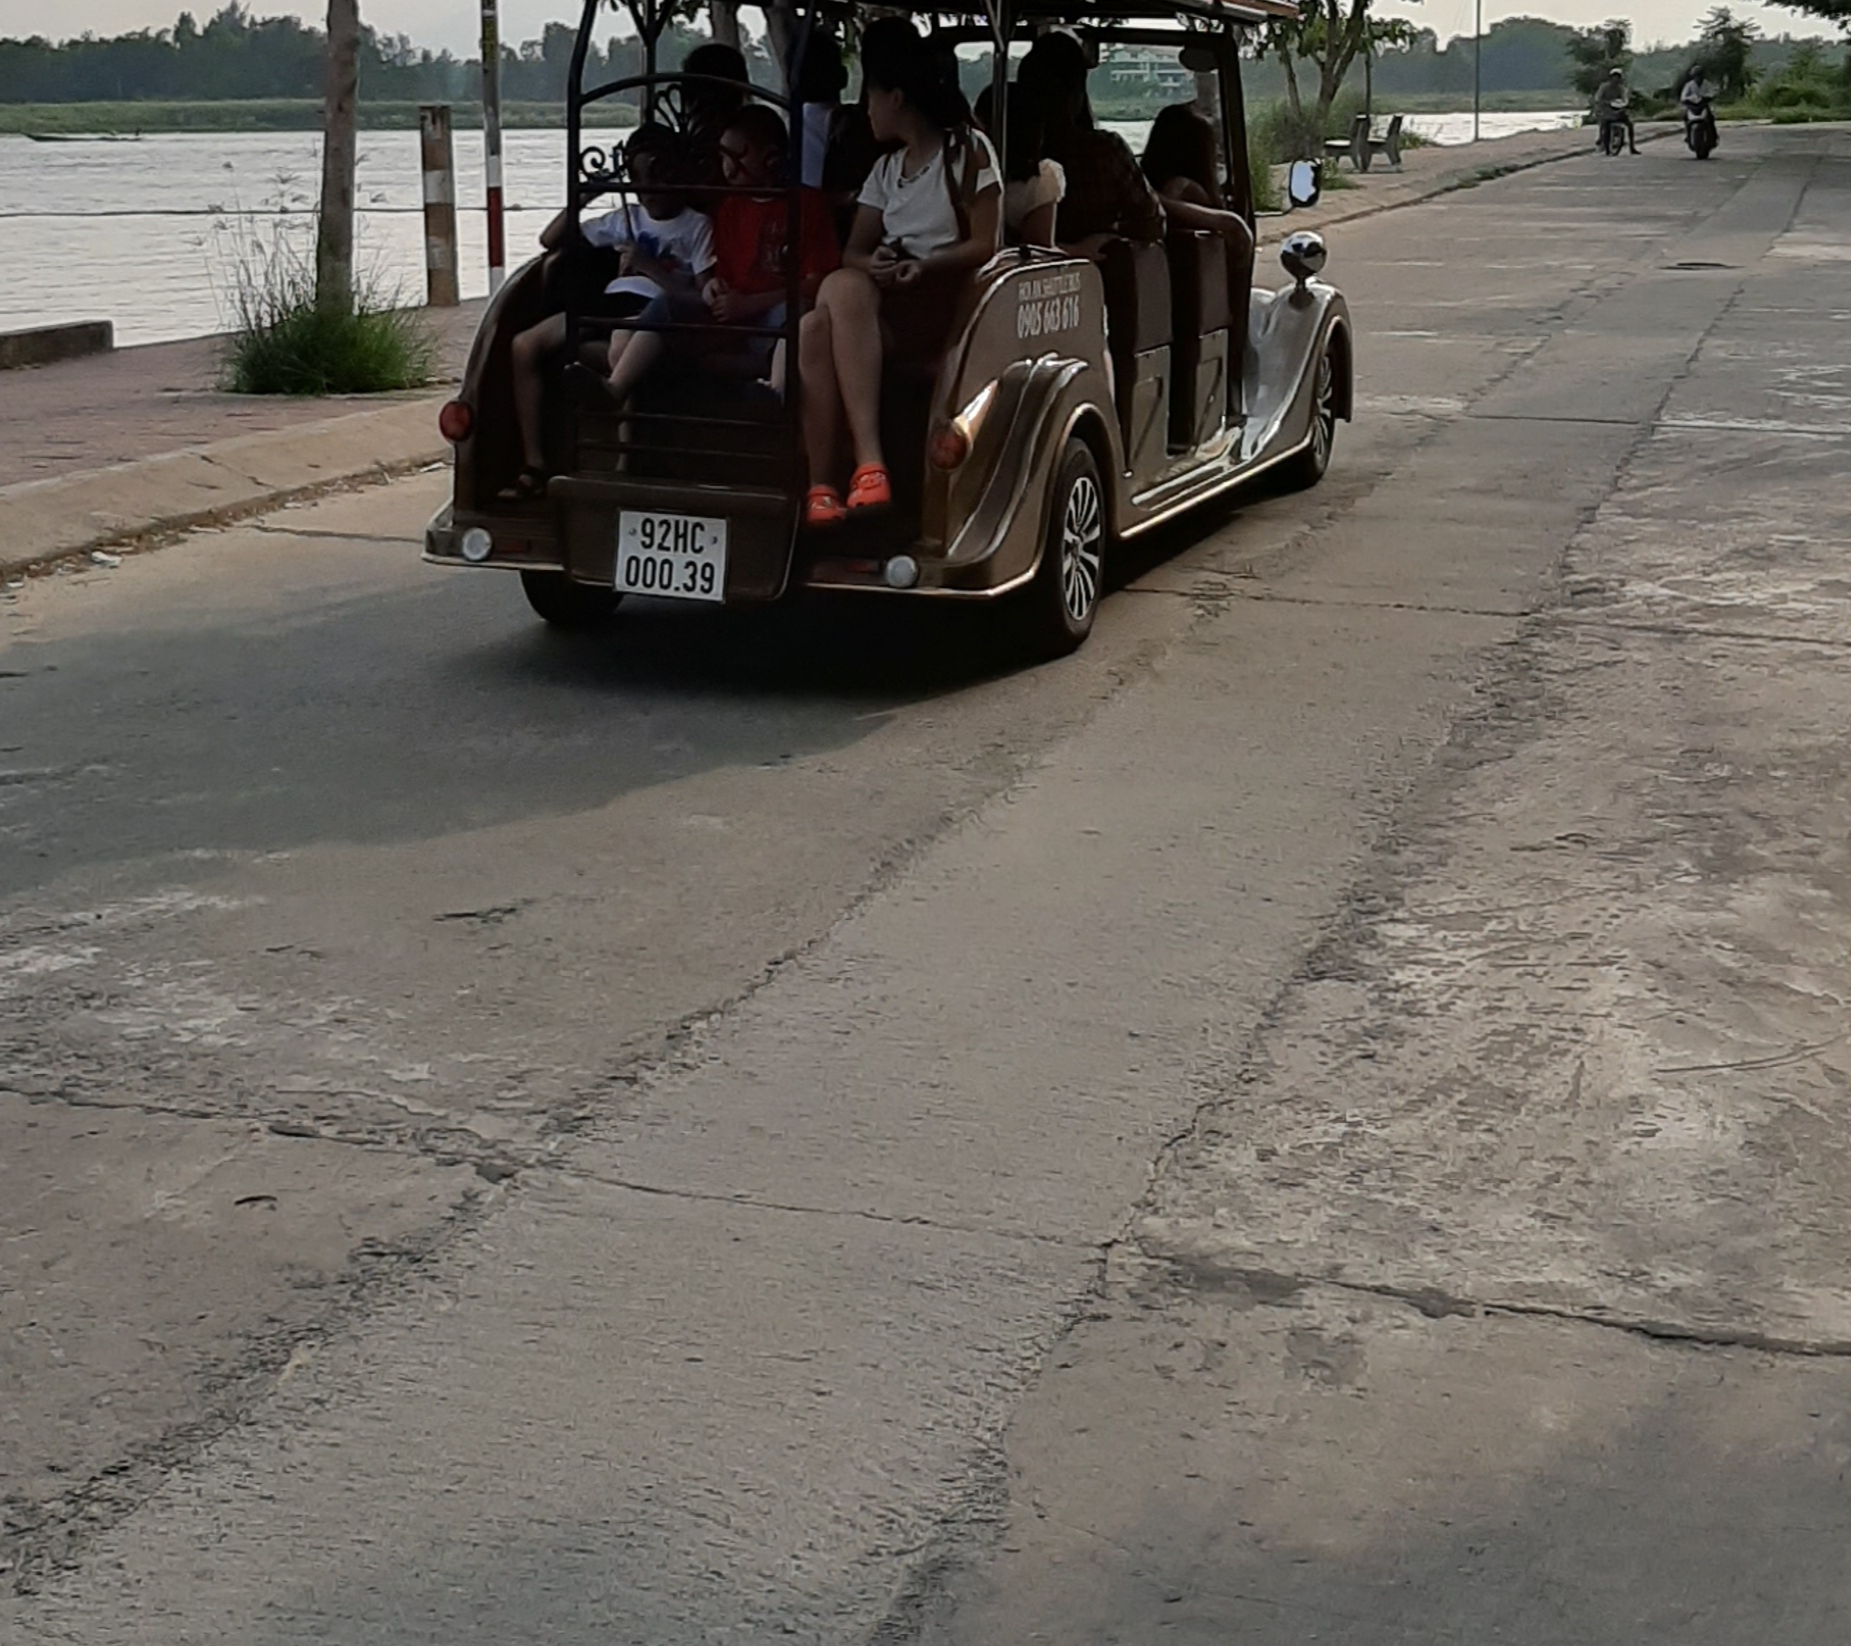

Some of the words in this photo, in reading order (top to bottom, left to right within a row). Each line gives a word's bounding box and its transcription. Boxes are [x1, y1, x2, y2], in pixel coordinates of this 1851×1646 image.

[1017, 302, 1042, 339] 0905
[1062, 295, 1079, 330] 616
[640, 517, 705, 554] 92HC
[625, 555, 715, 594] 000.39
